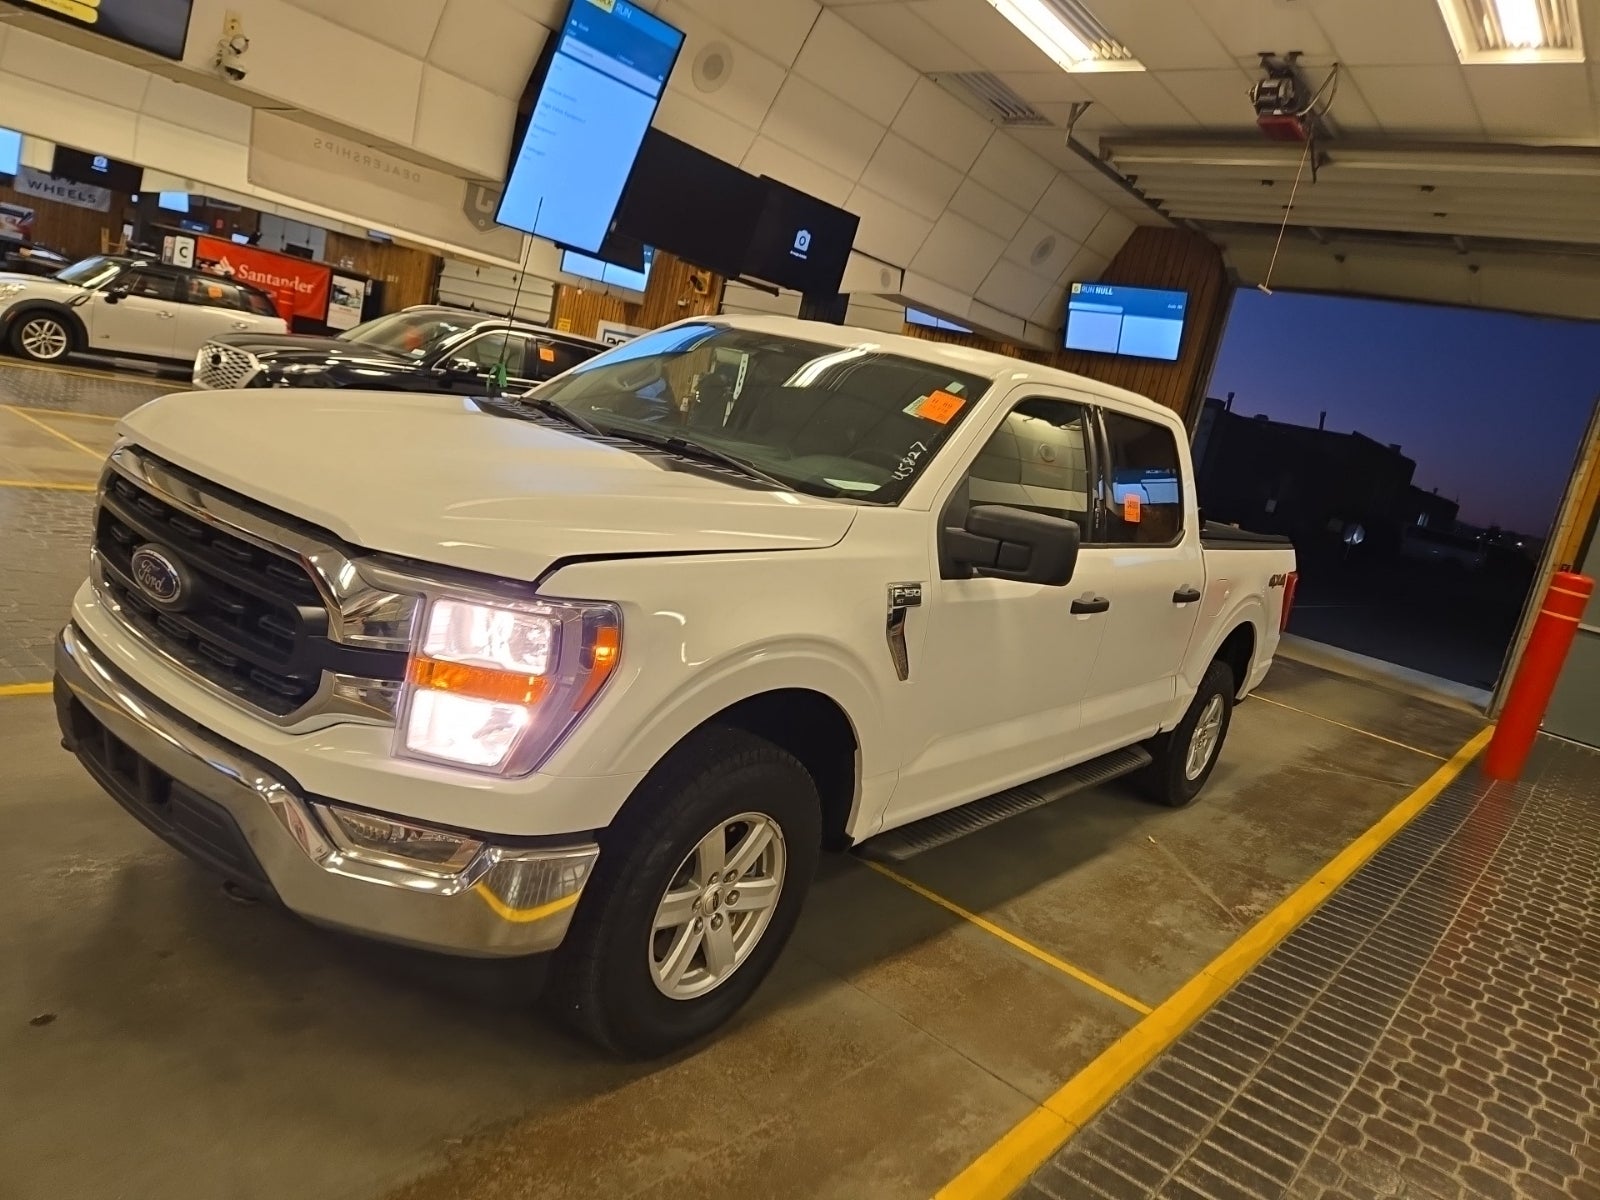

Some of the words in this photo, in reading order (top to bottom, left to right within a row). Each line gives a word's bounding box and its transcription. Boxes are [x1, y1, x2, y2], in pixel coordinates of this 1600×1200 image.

[615, 2, 632, 19] RUN
[27, 179, 97, 204] WHEELS
[238, 263, 315, 294] Santander
[1081, 285, 1095, 294] RUN
[1095, 286, 1113, 296] NULL
[138, 560, 165, 593] Ford
